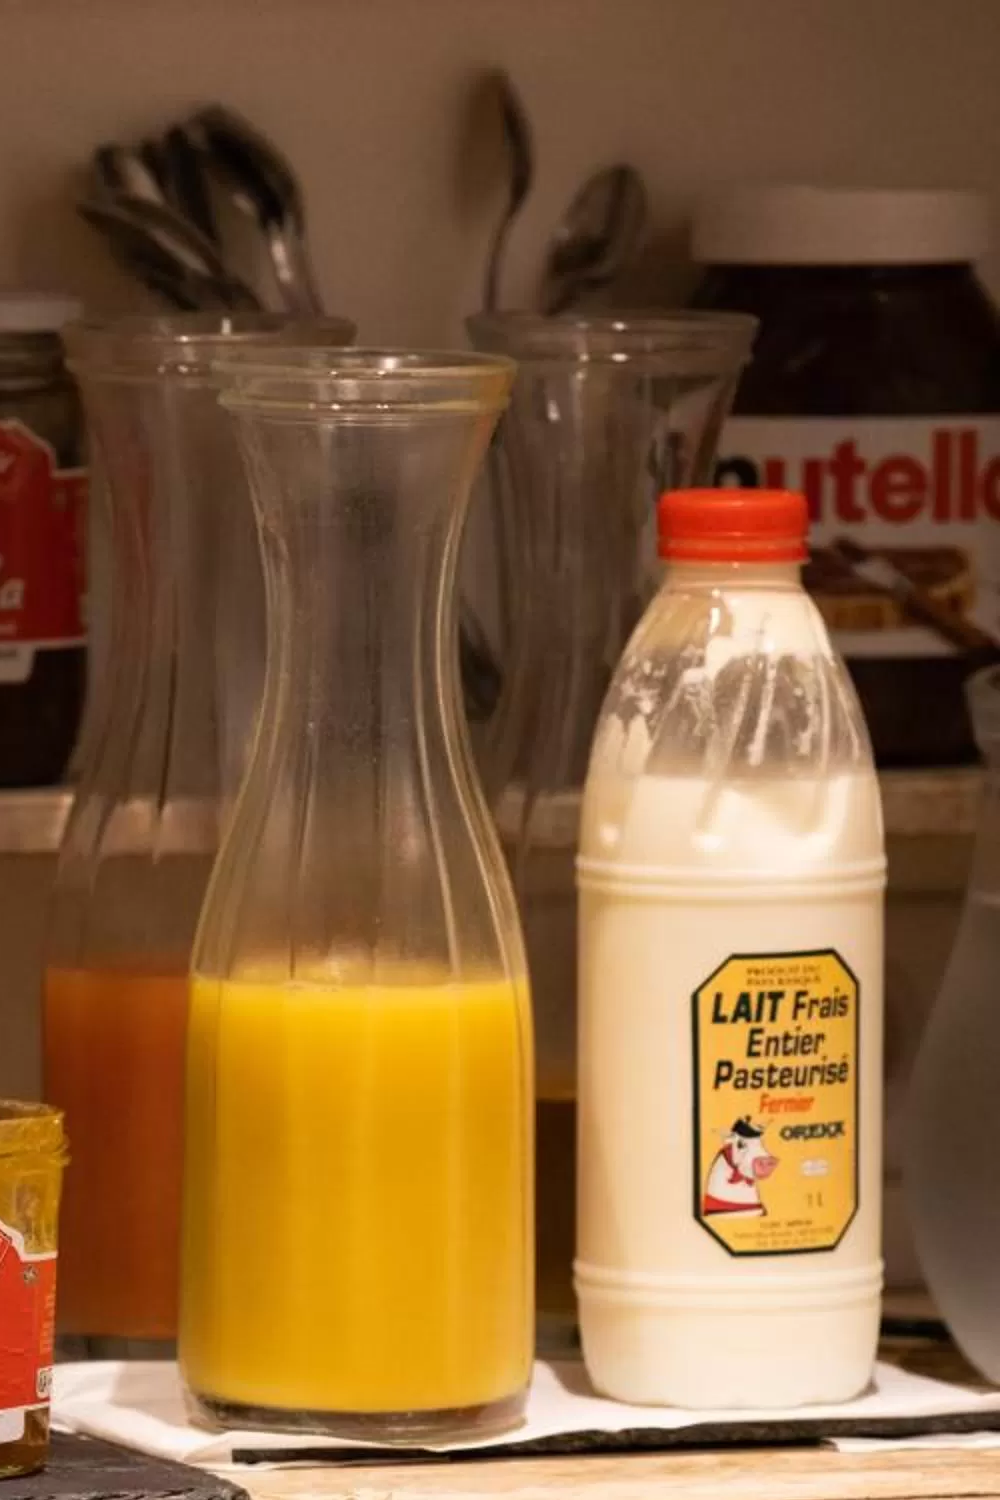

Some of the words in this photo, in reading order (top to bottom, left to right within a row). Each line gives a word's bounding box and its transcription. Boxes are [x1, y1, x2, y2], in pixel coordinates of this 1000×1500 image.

[713, 426, 1000, 525] utell
[711, 991, 785, 1024] LAIT
[791, 986, 849, 1021] Frais
[745, 1025, 826, 1059] Entier
[713, 1053, 849, 1090] Pasteurisé
